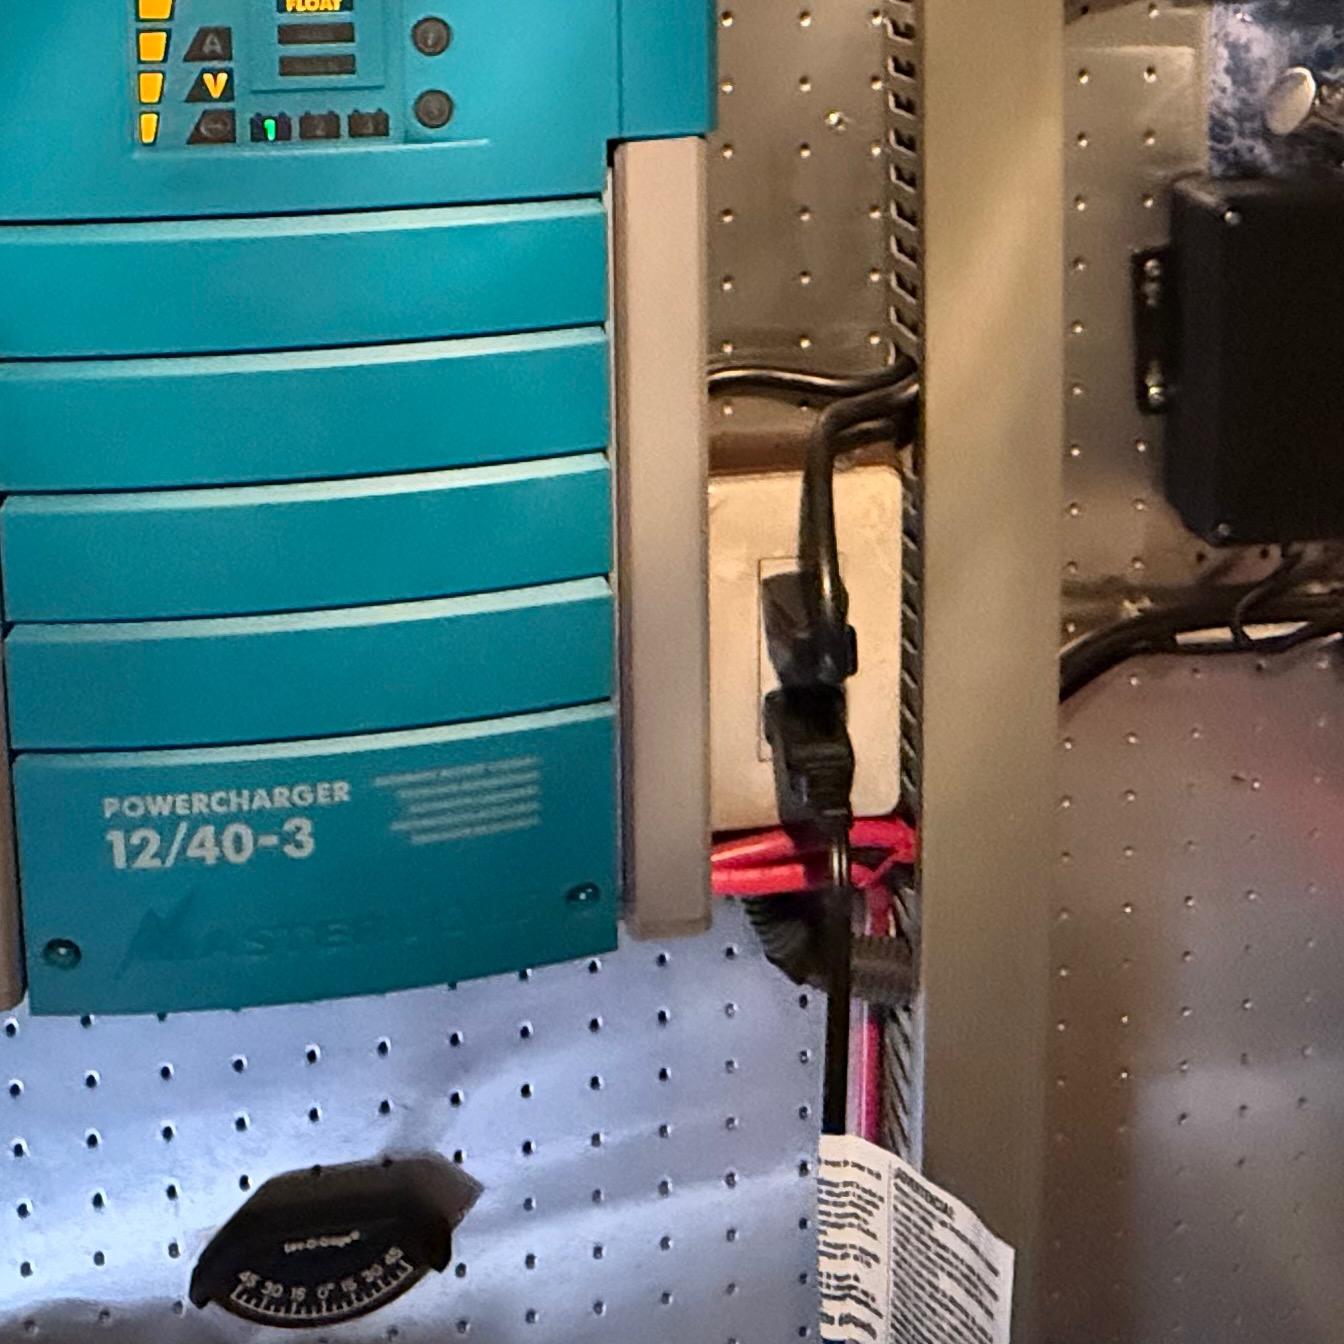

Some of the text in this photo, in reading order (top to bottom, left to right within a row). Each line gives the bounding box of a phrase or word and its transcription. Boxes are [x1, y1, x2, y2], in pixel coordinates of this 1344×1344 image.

[201, 72, 229, 100] V
[263, 118, 277, 143] 1
[101, 780, 353, 820] POWERCHARGER
[105, 817, 317, 871] 12/40-3
[261, 1280, 284, 1298] 30
[290, 1287, 307, 1302] 15
